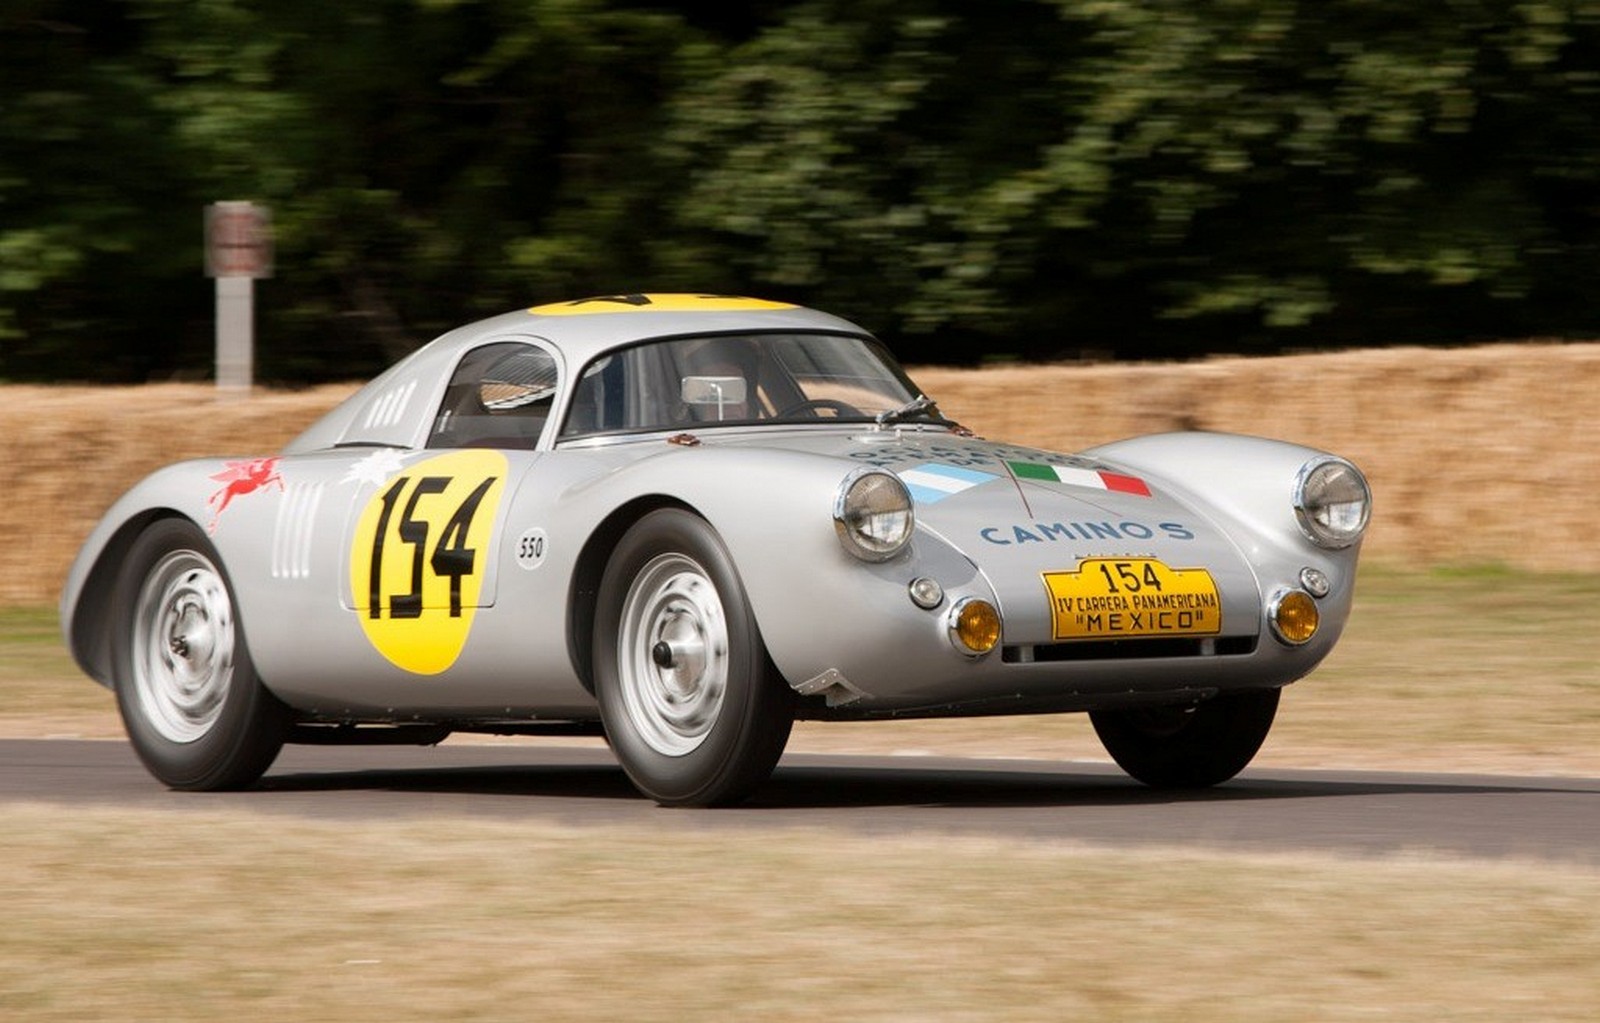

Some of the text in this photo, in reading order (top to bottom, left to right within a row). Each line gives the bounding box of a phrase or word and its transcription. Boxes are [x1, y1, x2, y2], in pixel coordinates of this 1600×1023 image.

[980, 521, 1195, 545] CAMINOS
[369, 476, 498, 619] 154
[519, 537, 543, 559] 550
[1100, 563, 1162, 593] 154
[1058, 593, 1216, 613] IV CARRERA PANAMERICANA
[1076, 611, 1203, 632] "MEXICO"
